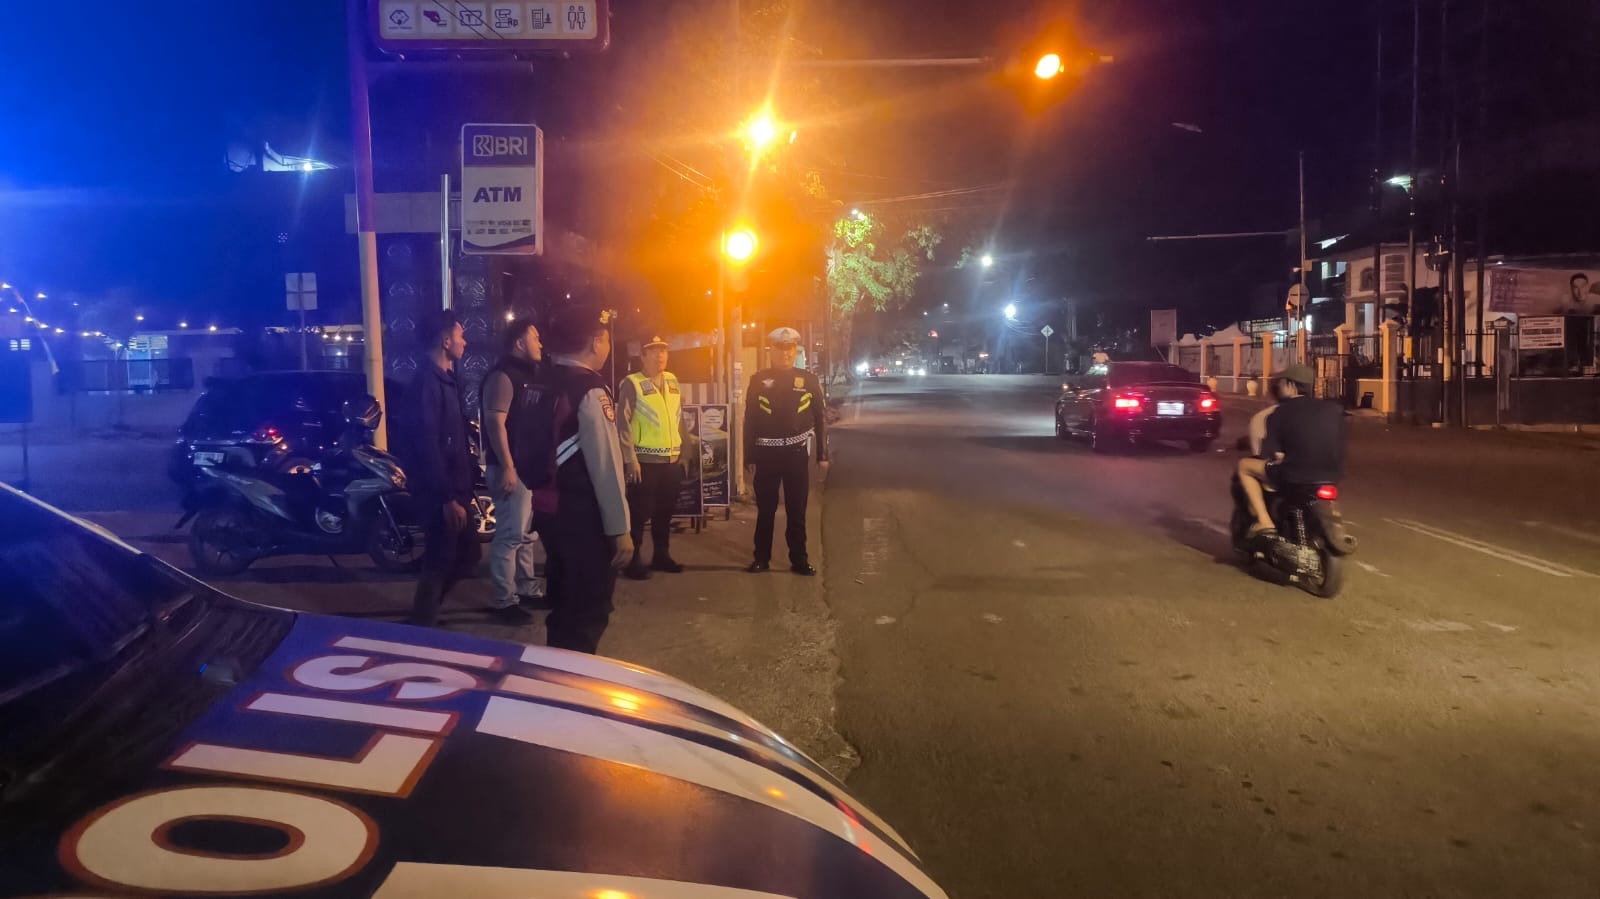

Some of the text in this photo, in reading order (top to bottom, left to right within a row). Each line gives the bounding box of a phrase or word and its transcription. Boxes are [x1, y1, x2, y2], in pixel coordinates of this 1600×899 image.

[495, 136, 528, 156] BRI
[472, 186, 522, 203] ATM
[58, 634, 504, 899] OLISI
